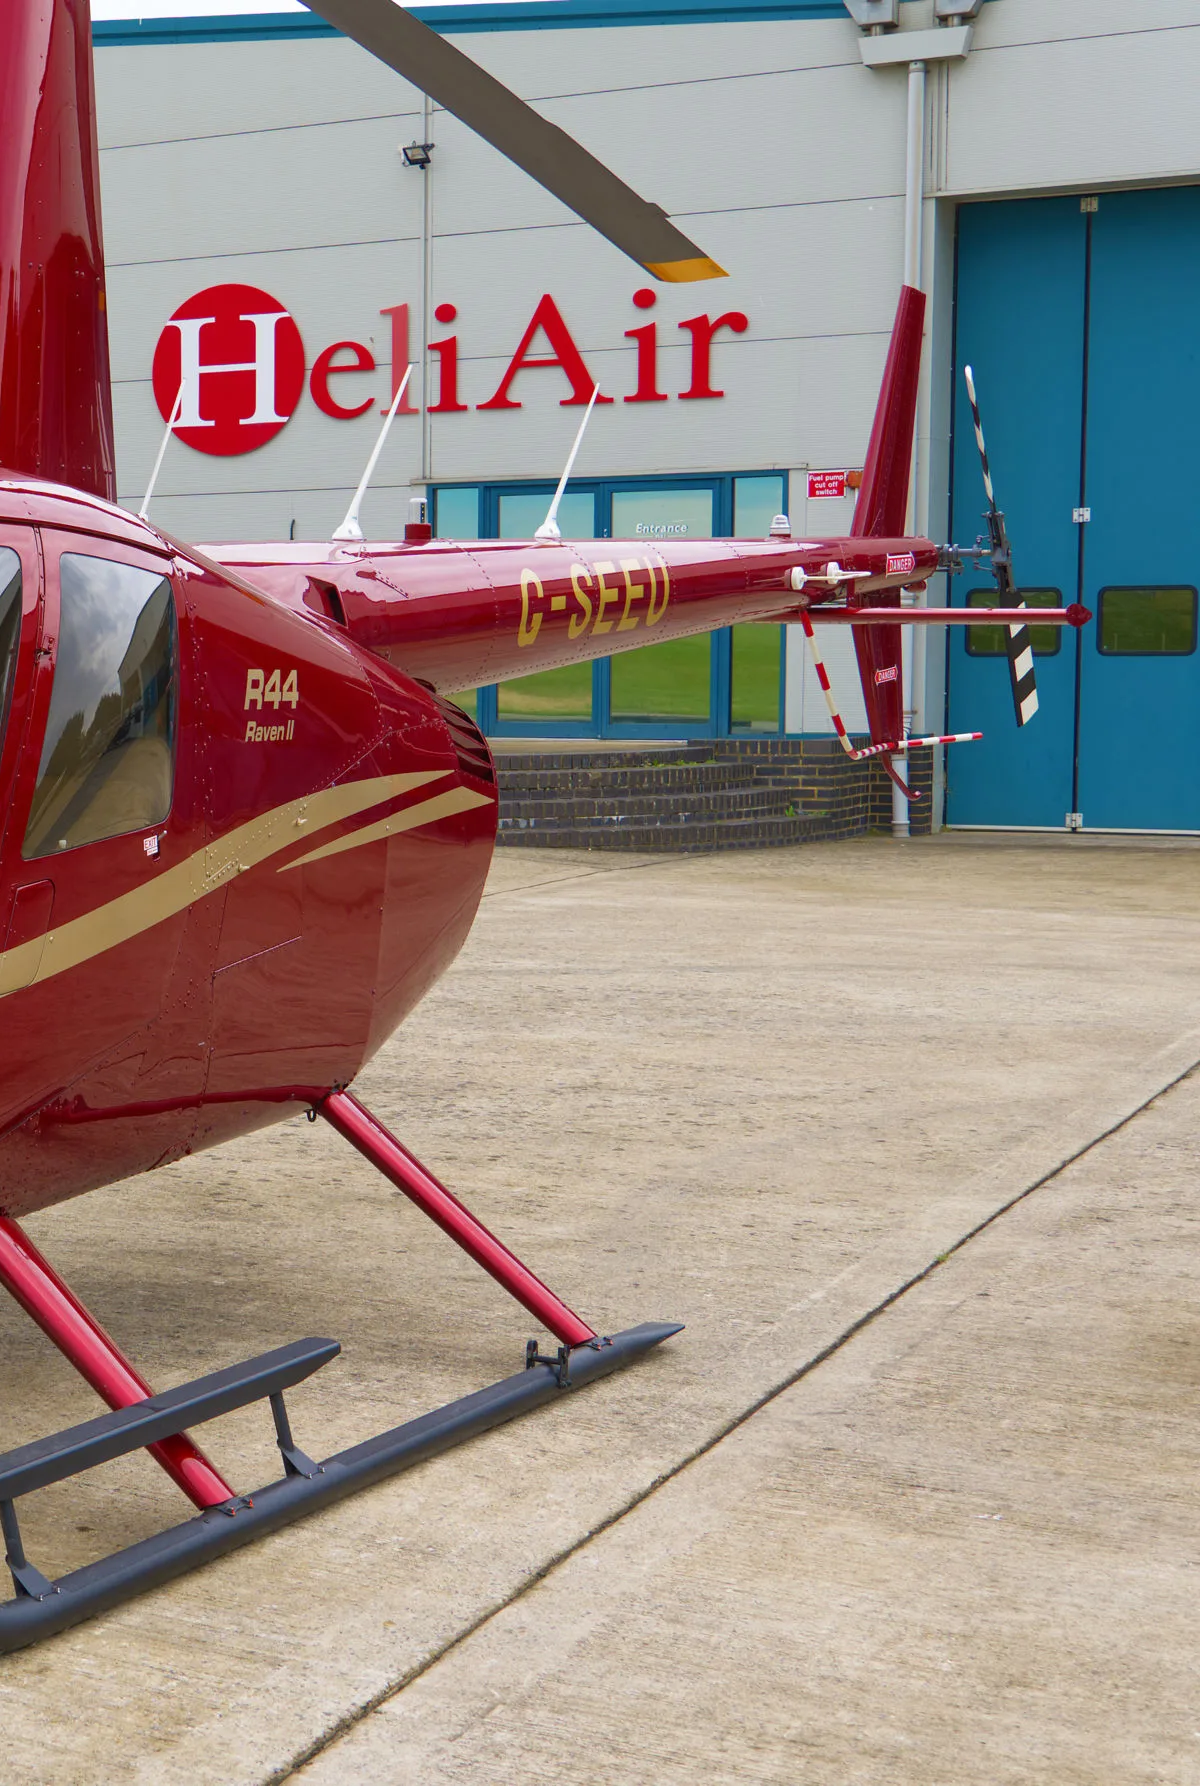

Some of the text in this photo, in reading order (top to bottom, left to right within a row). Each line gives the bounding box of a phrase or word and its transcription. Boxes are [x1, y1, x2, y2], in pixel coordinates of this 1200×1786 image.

[164, 288, 749, 428] HeliAir
[825, 475, 844, 483] pump
[636, 523, 687, 533] Entrance
[889, 558, 912, 571] DANGER
[244, 669, 299, 710] R44
[245, 721, 285, 742] Raven
